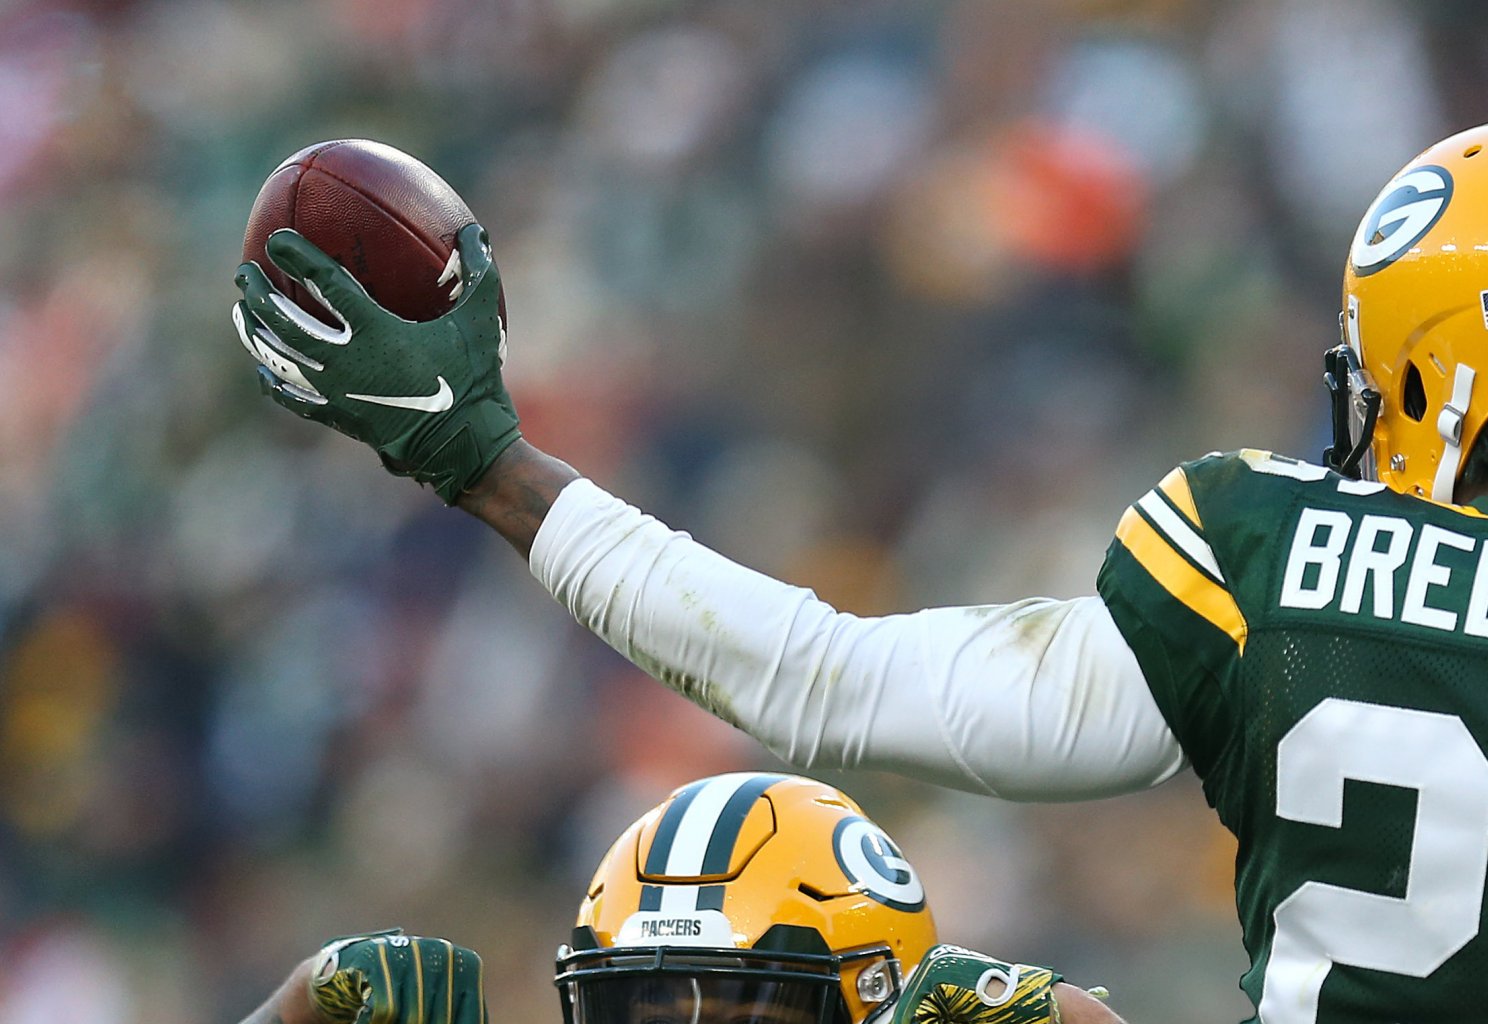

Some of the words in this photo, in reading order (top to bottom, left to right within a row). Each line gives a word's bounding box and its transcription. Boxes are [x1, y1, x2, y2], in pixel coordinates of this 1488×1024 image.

[1351, 169, 1446, 268] G
[839, 820, 924, 904] G
[641, 919, 702, 937] PACKERS
